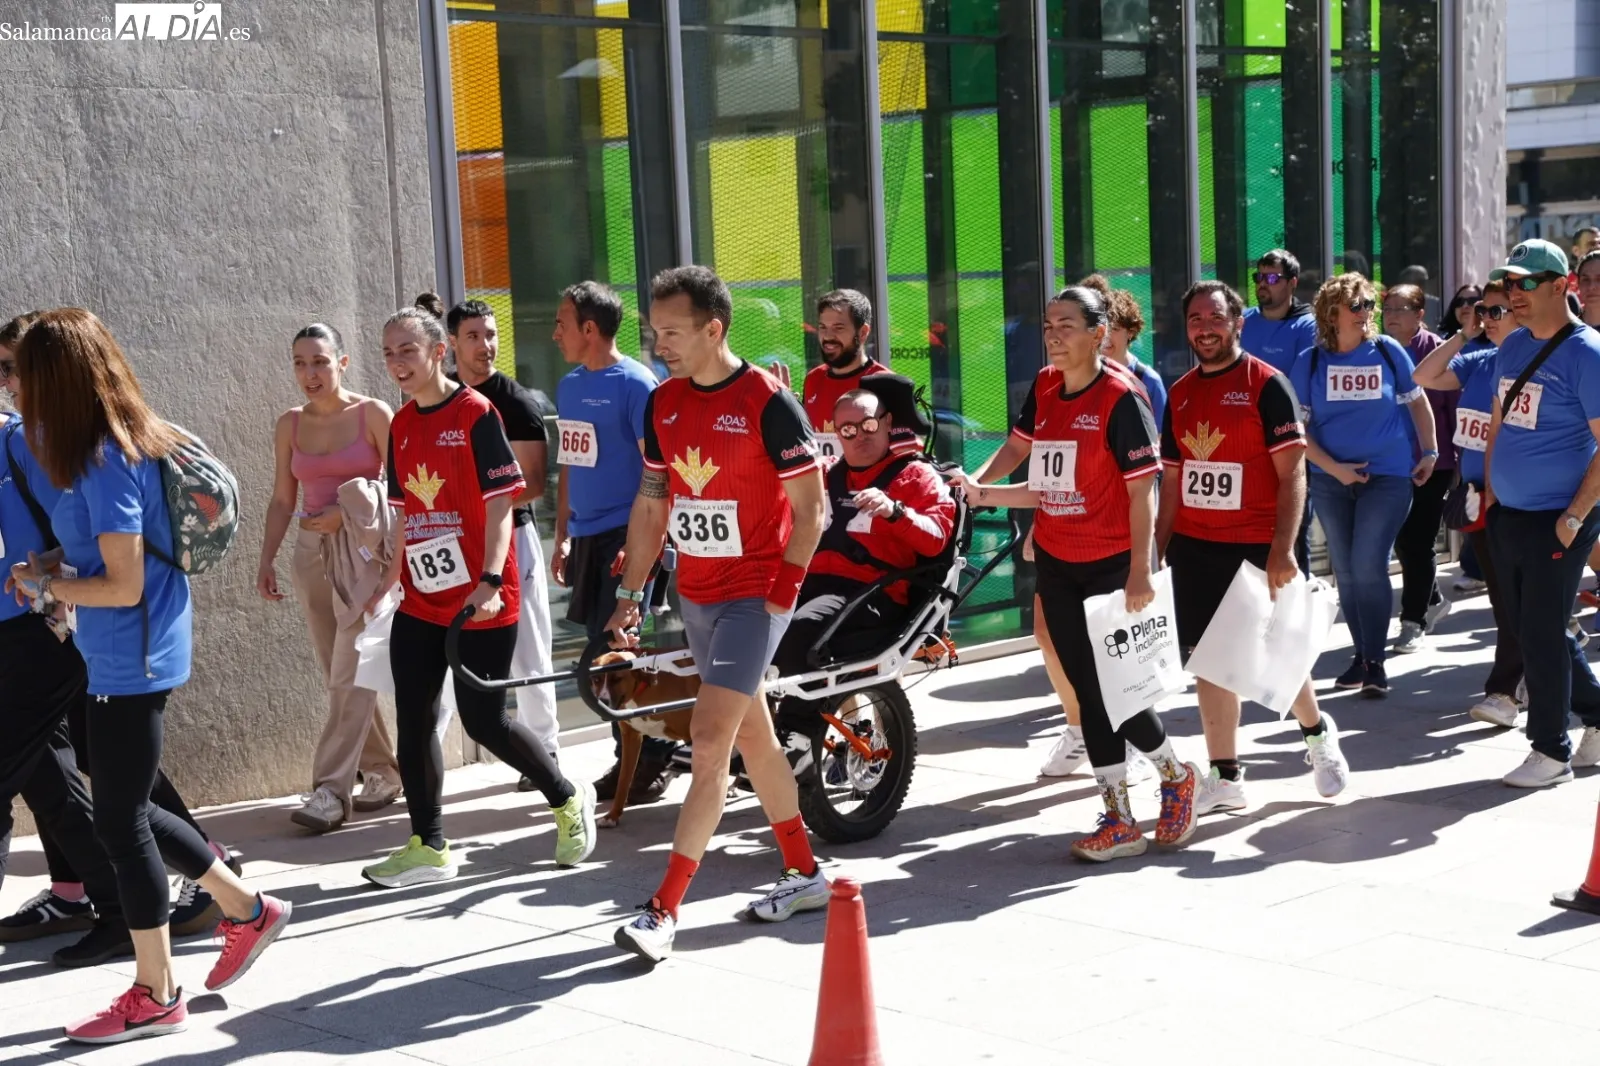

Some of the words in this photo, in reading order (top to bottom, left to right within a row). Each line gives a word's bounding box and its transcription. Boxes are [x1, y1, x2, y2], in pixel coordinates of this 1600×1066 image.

[1329, 374, 1380, 392] 1690
[1224, 391, 1250, 401] ADAS
[716, 414, 747, 428] ADAS
[1075, 414, 1100, 425] ADAS
[439, 429, 466, 440] ADAS
[724, 426, 749, 435] Deportivo
[562, 430, 590, 454] 666
[1042, 451, 1064, 478] 10
[1188, 470, 1233, 497] 299
[717, 503, 735, 511] LEÓN
[677, 512, 729, 542] 336
[410, 547, 456, 581] 183
[1130, 615, 1168, 642] Plena
